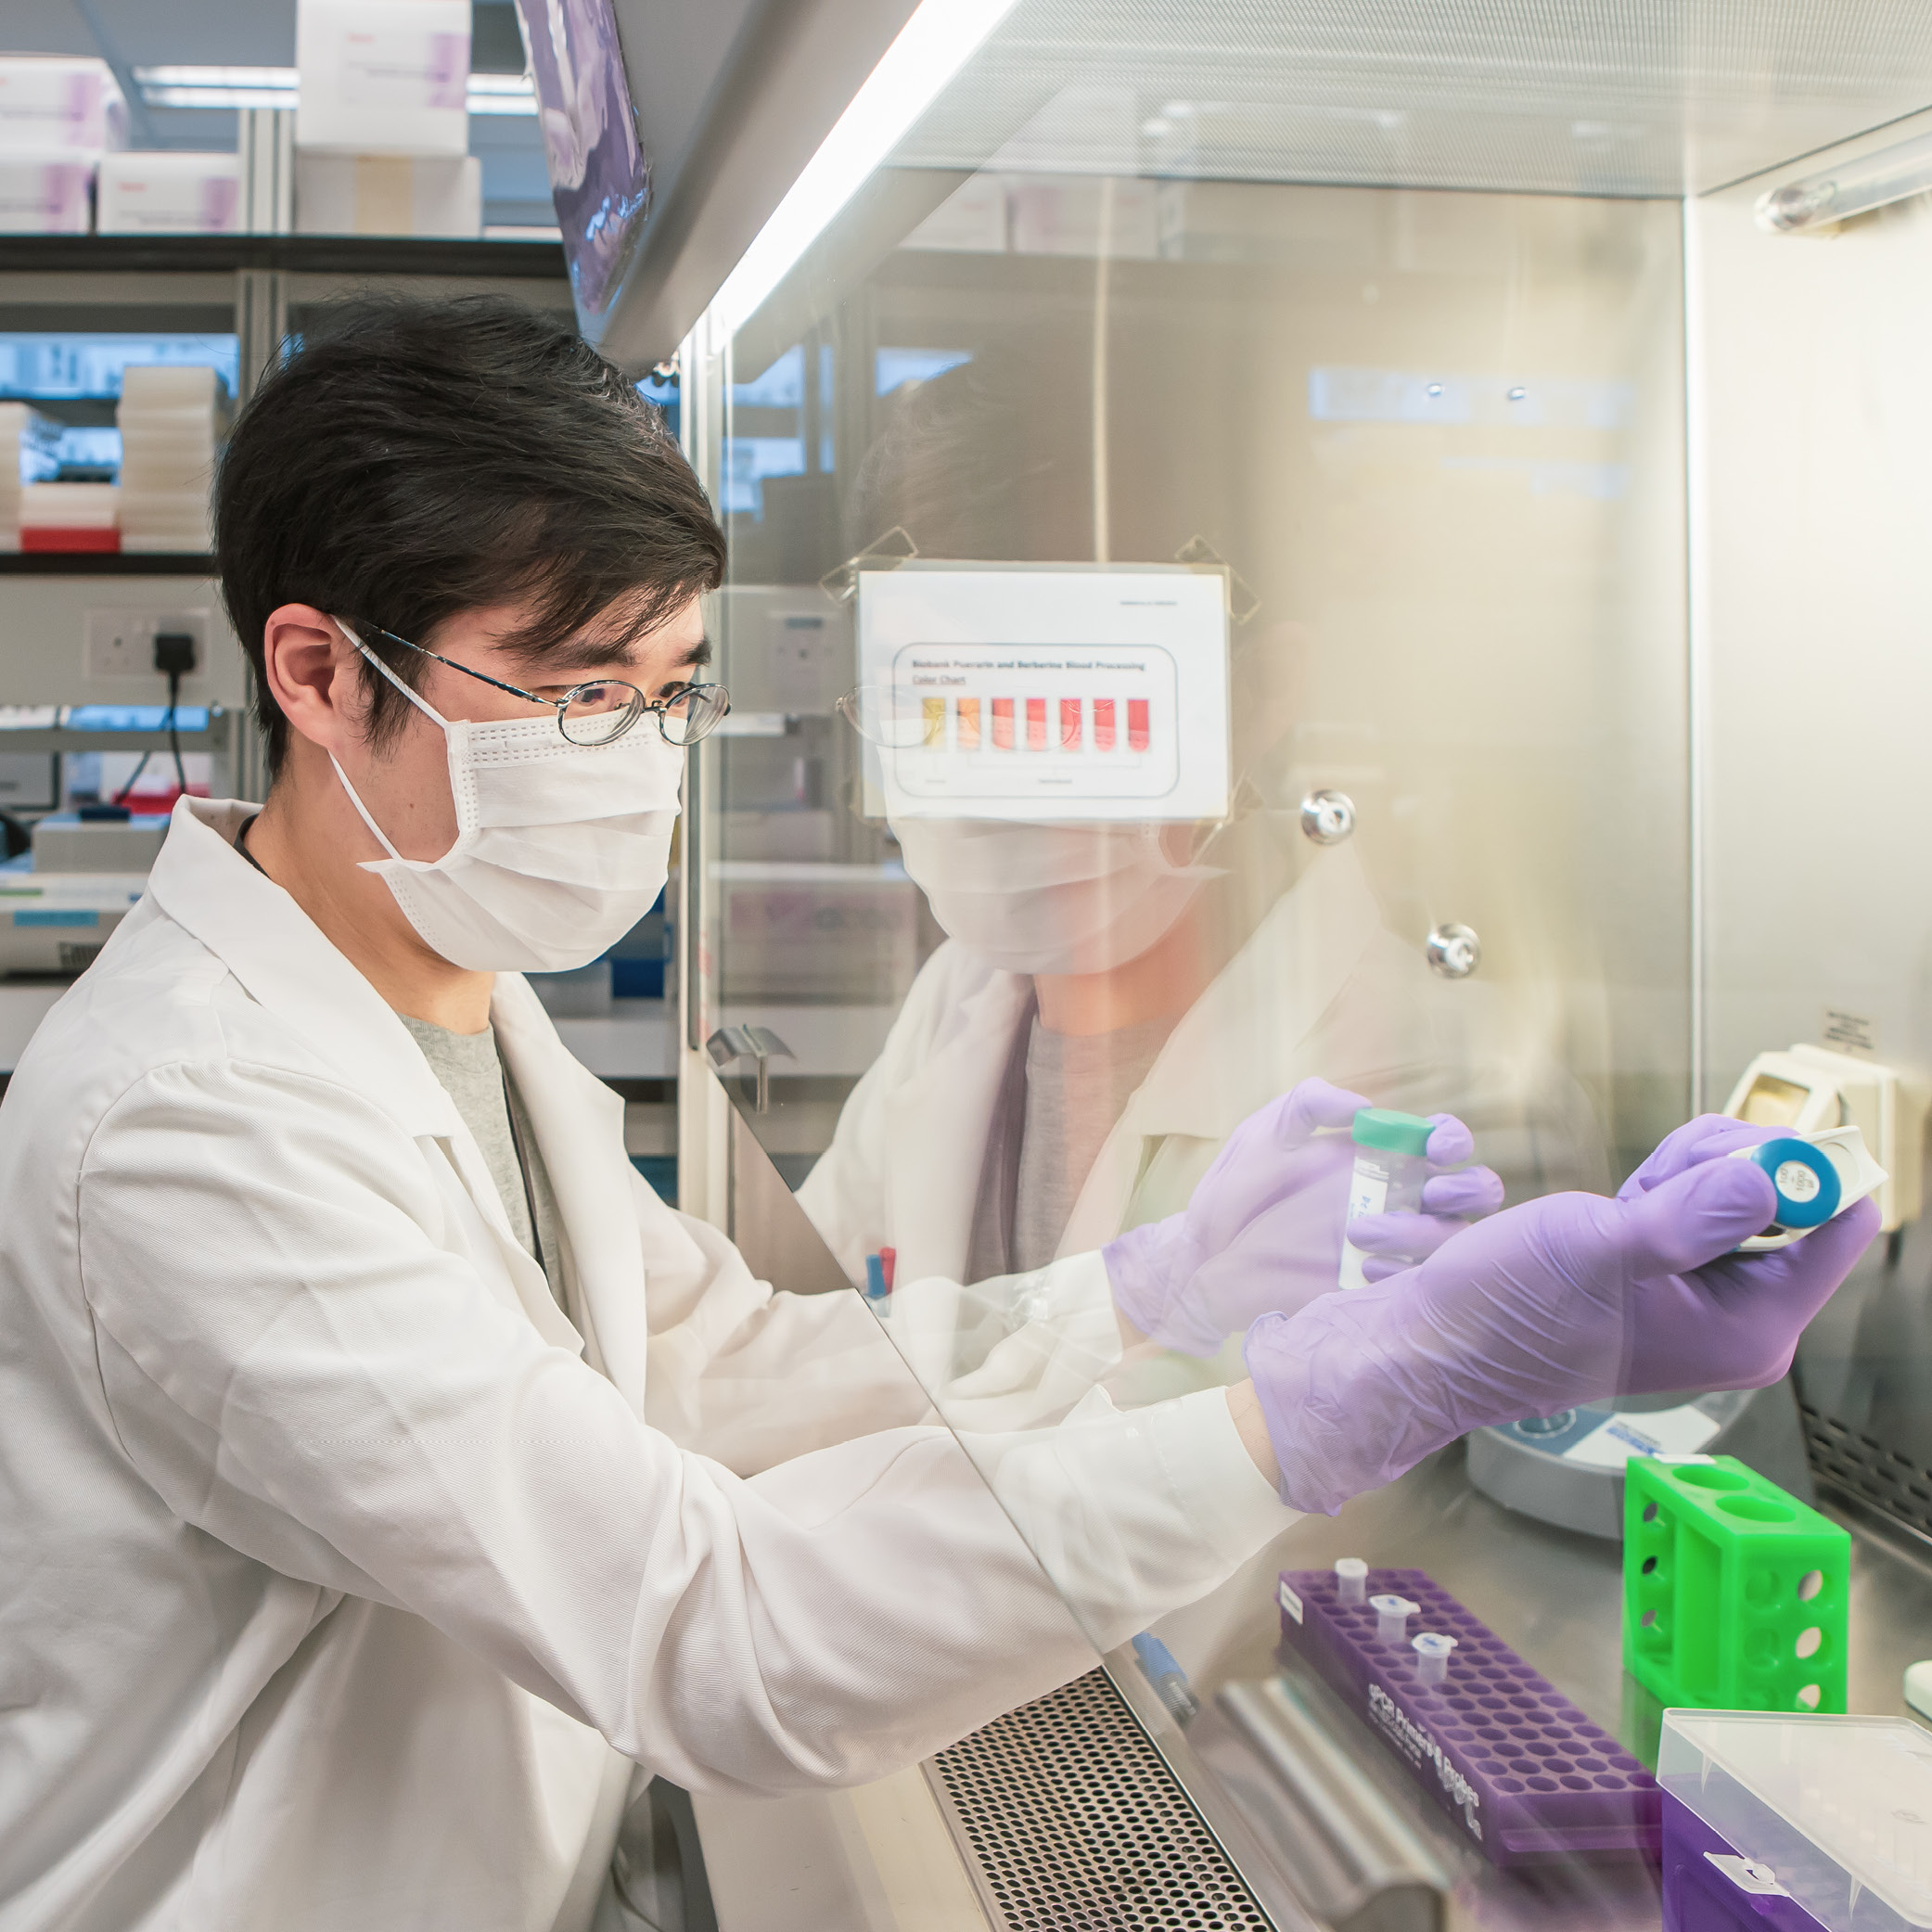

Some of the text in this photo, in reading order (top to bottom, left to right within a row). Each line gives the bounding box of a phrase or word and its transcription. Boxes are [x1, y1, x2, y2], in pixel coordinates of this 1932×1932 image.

[997, 660, 1014, 669] and
[1066, 660, 1092, 669] Blood
[1095, 660, 1145, 672] Processing
[940, 675, 966, 685] Chart
